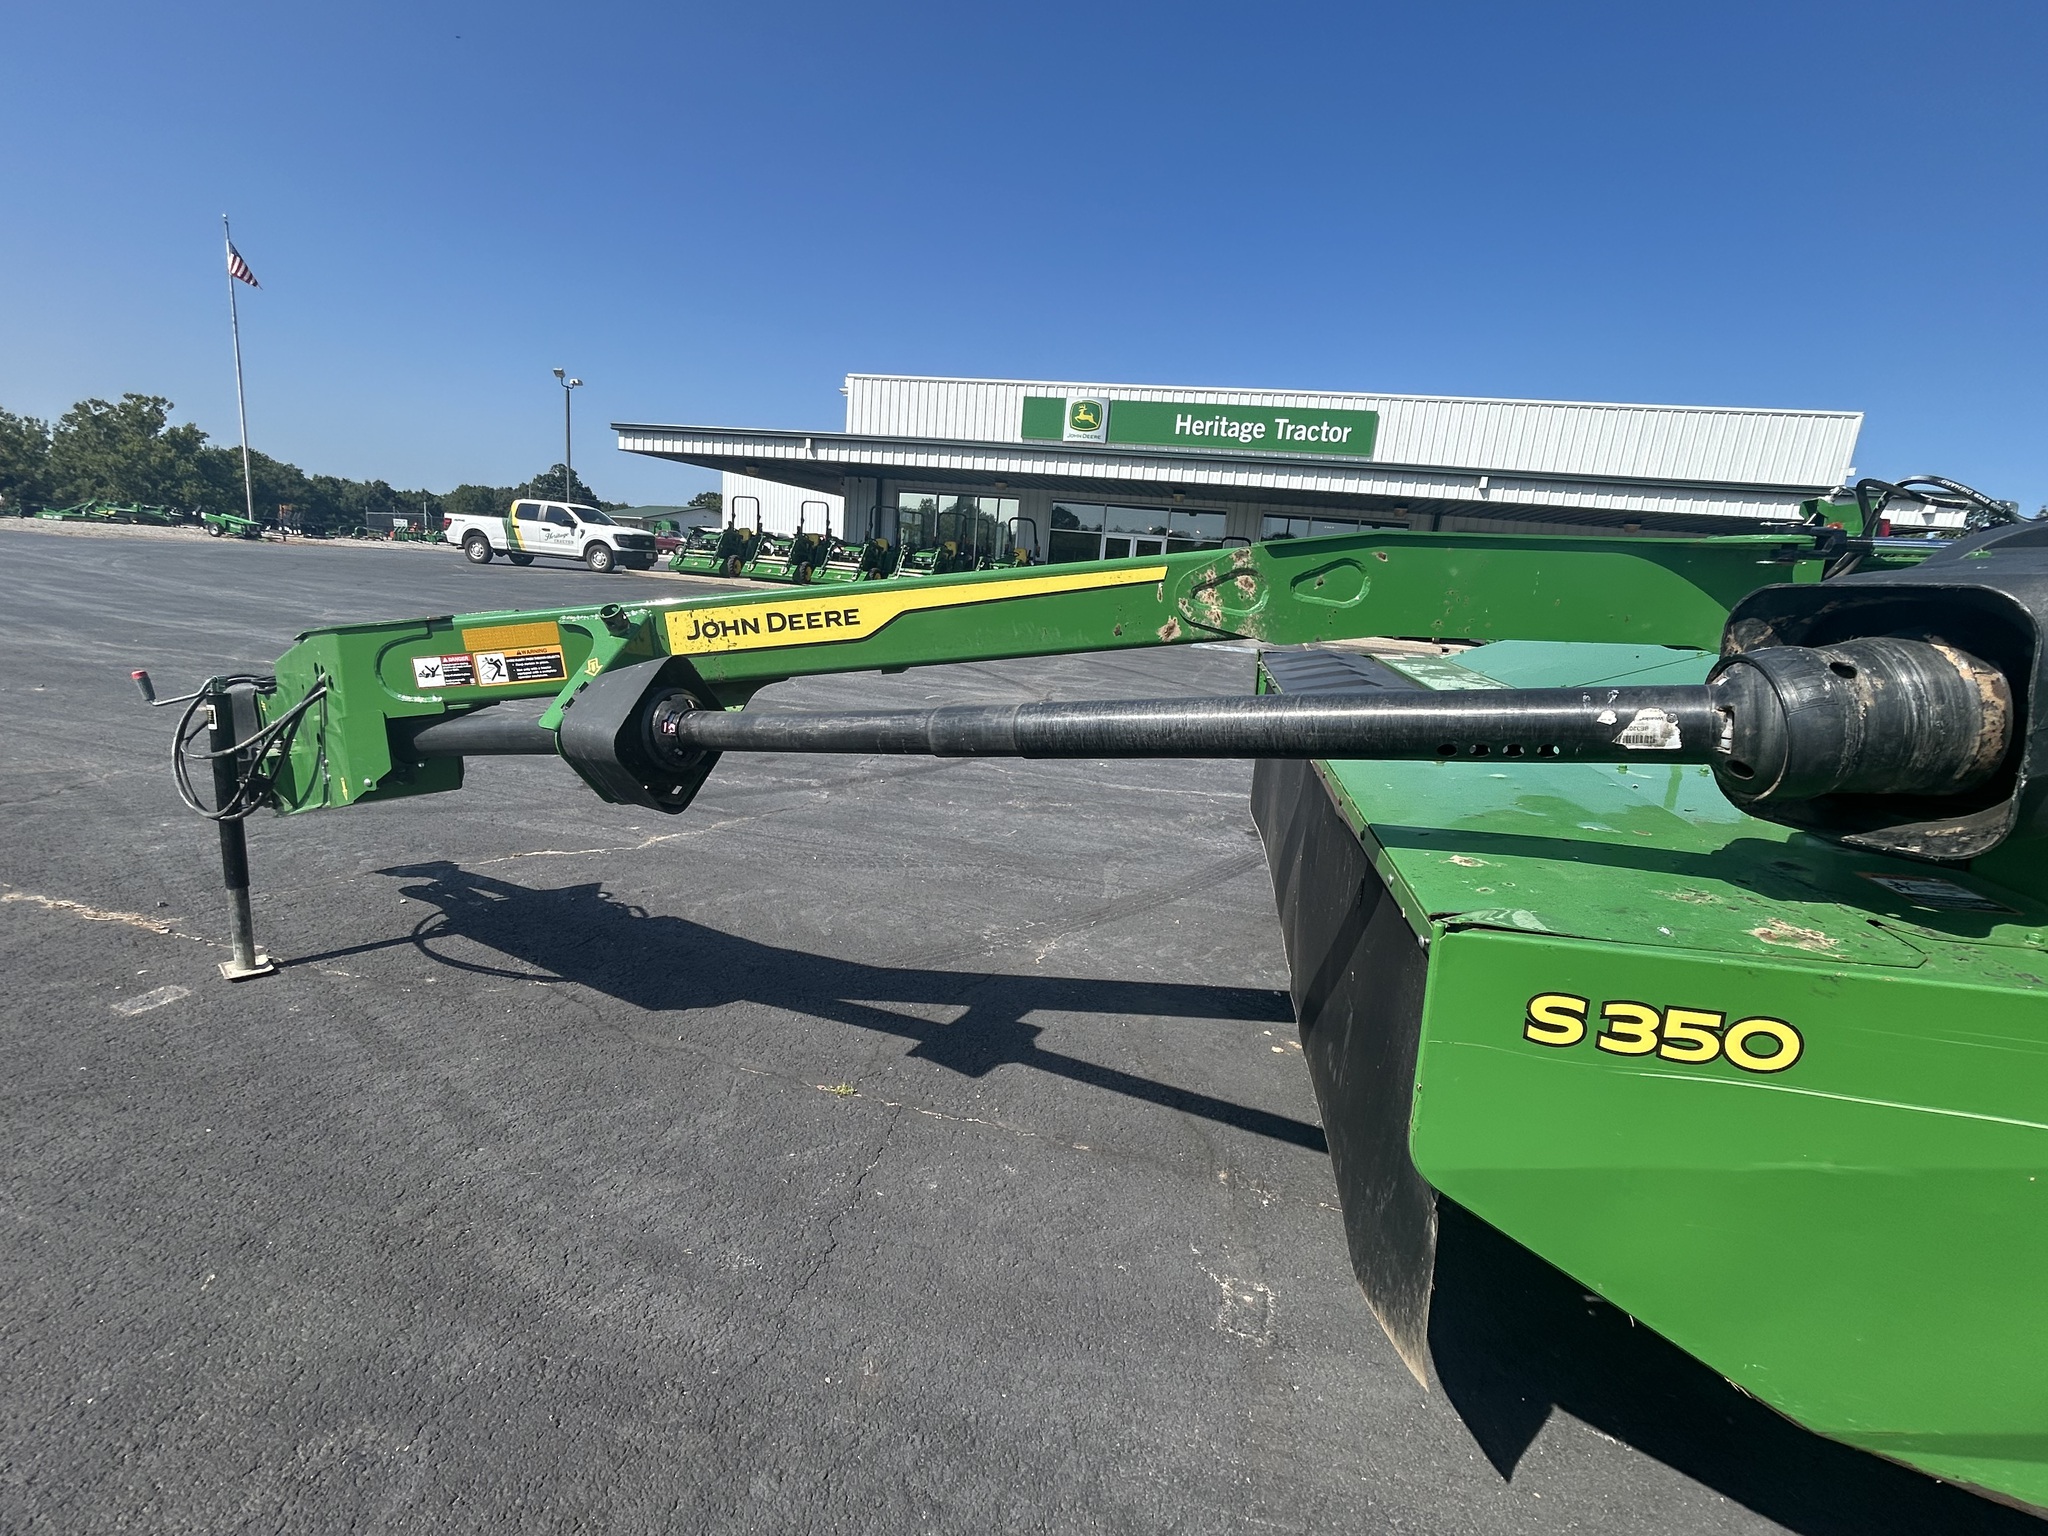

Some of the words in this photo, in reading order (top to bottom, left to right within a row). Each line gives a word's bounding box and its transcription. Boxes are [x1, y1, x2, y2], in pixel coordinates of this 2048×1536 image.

[1175, 414, 1266, 443] Heritage
[1274, 418, 1352, 443] Tractor
[687, 617, 761, 641] JOHN
[766, 608, 861, 633] DEERE
[1522, 991, 1590, 1048] S
[1595, 1000, 1805, 1074] 350
